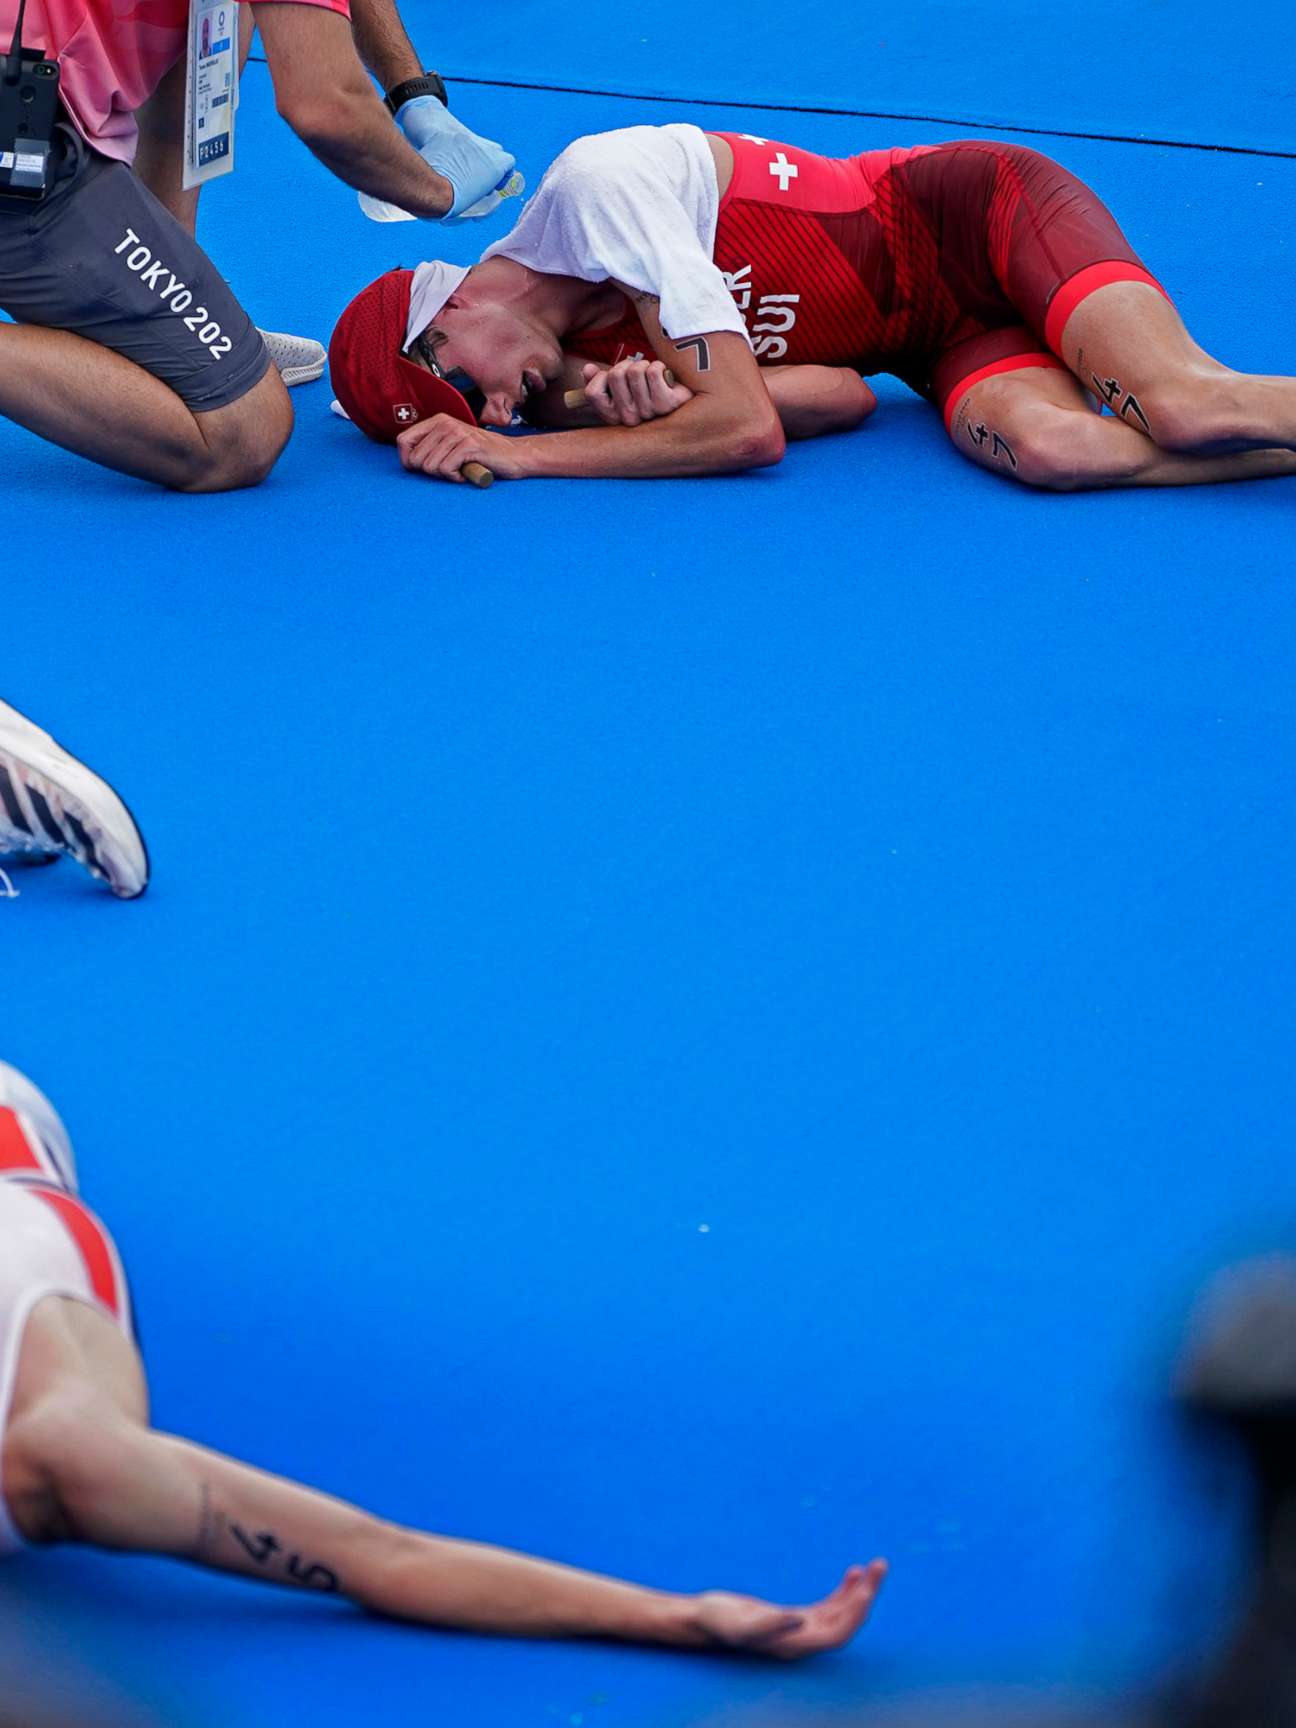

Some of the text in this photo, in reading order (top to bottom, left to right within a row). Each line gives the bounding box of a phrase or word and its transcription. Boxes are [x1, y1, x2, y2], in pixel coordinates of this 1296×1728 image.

[114, 228, 193, 312] TOKYO
[750, 294, 800, 359] SUI
[1090, 371, 1152, 437] 47
[966, 417, 1019, 474] 47
